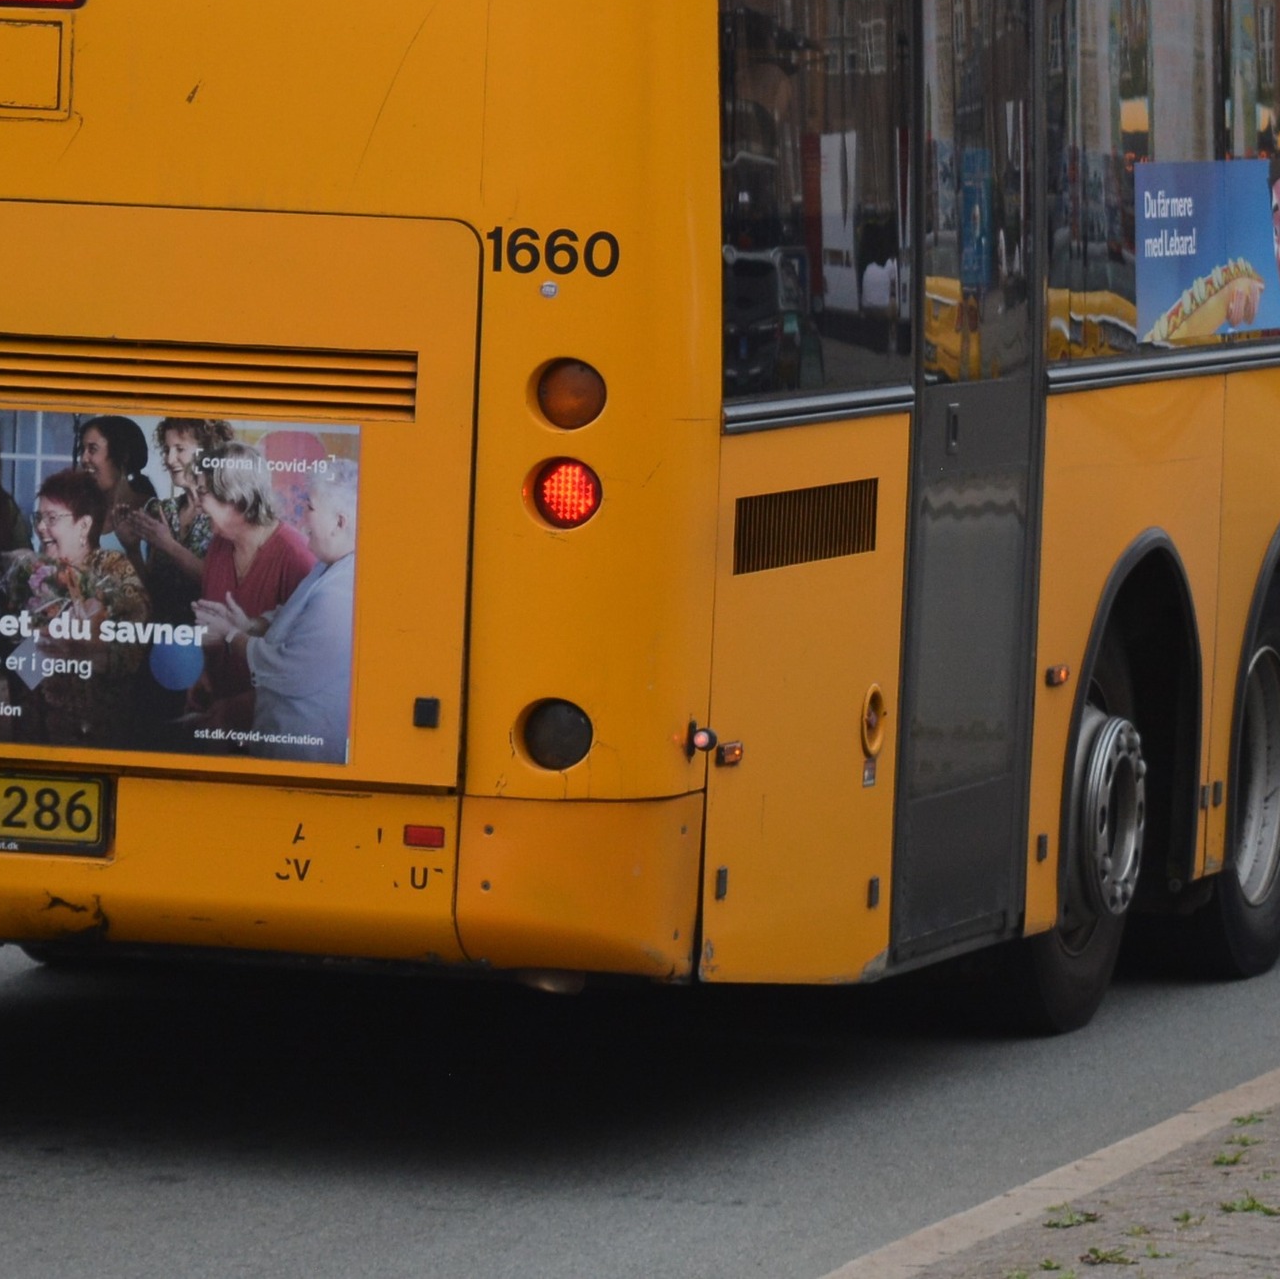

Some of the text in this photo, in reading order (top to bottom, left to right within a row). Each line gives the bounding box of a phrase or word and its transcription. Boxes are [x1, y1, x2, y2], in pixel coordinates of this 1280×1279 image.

[1144, 191, 1157, 219] Du
[1170, 194, 1193, 218] mere
[486, 226, 620, 278] 1660
[1145, 227, 1196, 258] med Lebara!
[202, 457, 328, 473] corona covid-19
[48, 610, 91, 640] du
[99, 619, 209, 647] savner
[5, 655, 26, 671] er
[31, 653, 37, 672] i
[41, 657, 93, 680] gang
[193, 728, 324, 747] sst.dk/covid-vaccination
